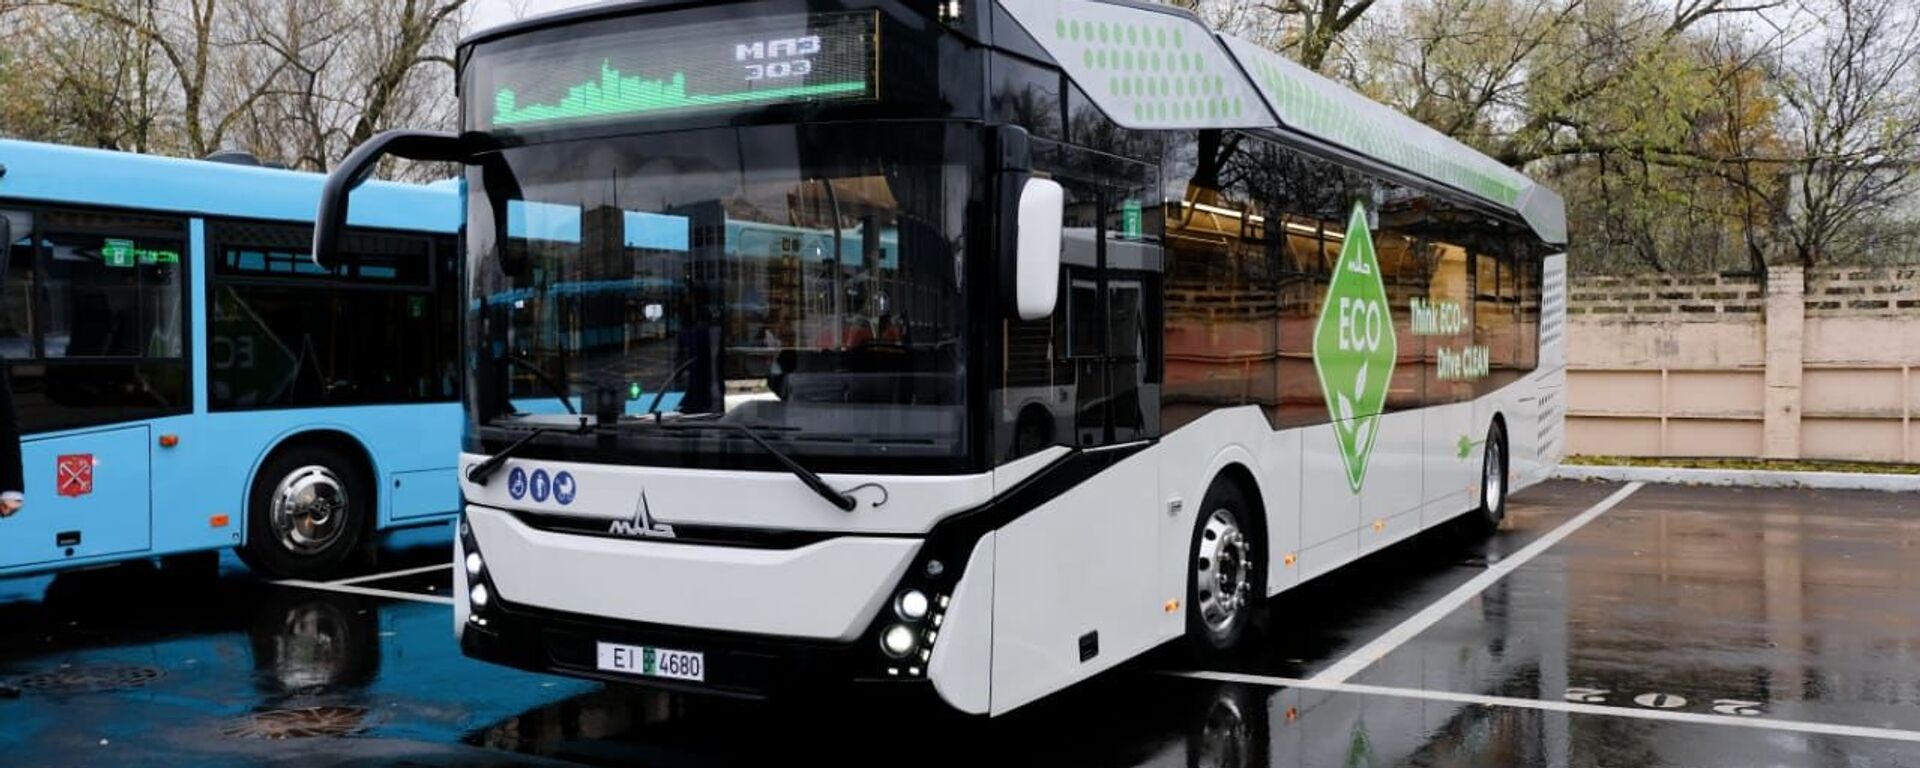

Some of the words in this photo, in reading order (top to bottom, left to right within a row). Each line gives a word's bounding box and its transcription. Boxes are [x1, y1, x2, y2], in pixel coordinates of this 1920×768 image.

[736, 35, 821, 61] МАЗ
[745, 59, 811, 80] 303
[1338, 297, 1382, 352] ECO
[1410, 297, 1438, 335] Think
[1440, 302, 1460, 334] ECO
[1437, 345, 1461, 379] Drive
[1462, 344, 1489, 377] CLEAN
[614, 648, 634, 669] EI
[660, 652, 700, 677] 4680
